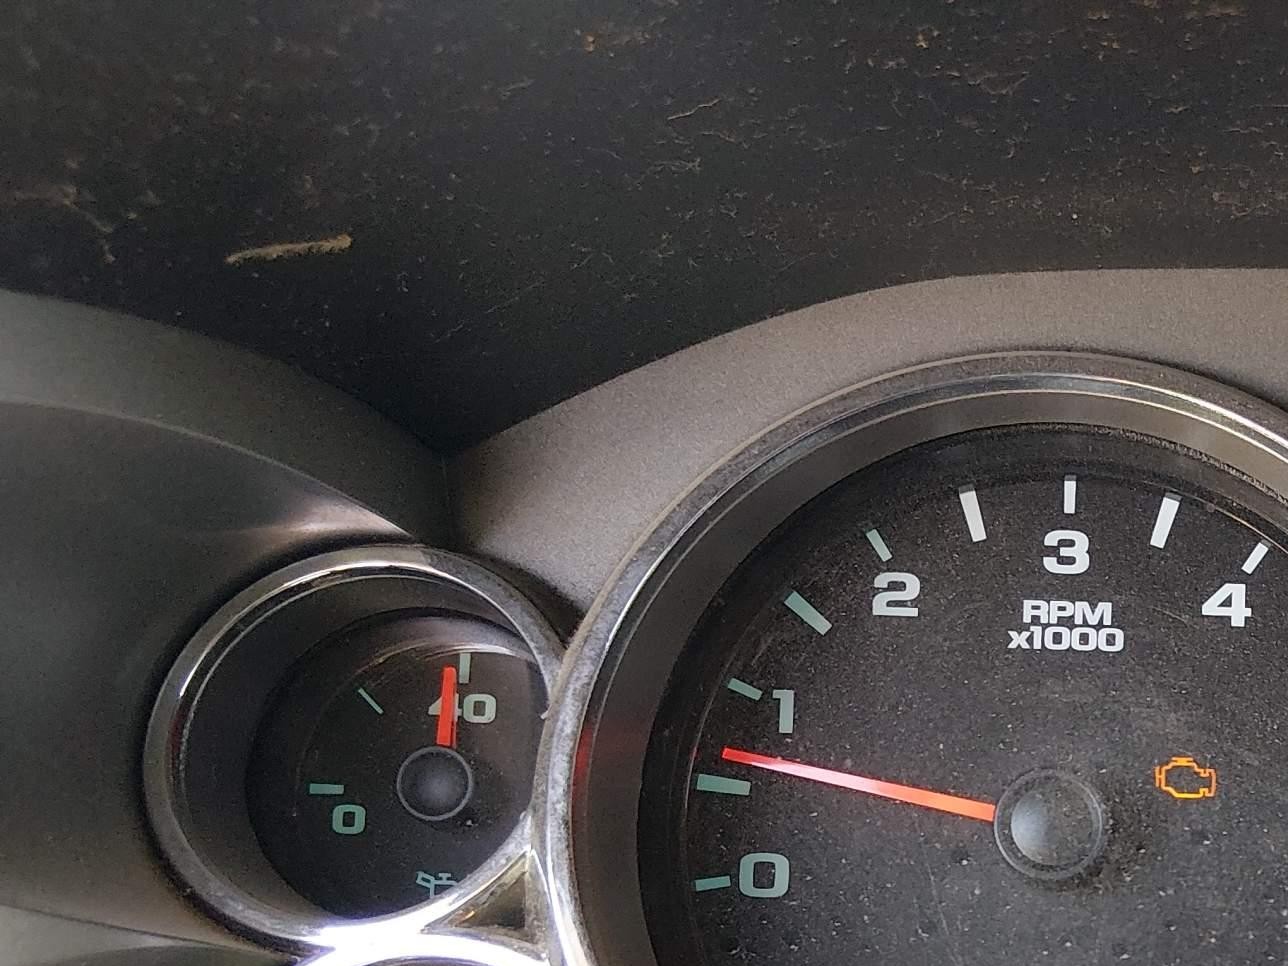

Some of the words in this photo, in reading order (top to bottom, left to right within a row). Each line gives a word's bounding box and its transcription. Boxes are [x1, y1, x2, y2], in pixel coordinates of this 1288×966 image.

[1042, 529, 1090, 575] 3
[872, 571, 921, 617] 2
[1022, 599, 1113, 625] RPM
[1201, 582, 1252, 628] 4
[1007, 625, 1125, 652] x1000
[772, 689, 795, 734] 1
[333, 804, 366, 834] 0
[738, 852, 790, 898] 0
